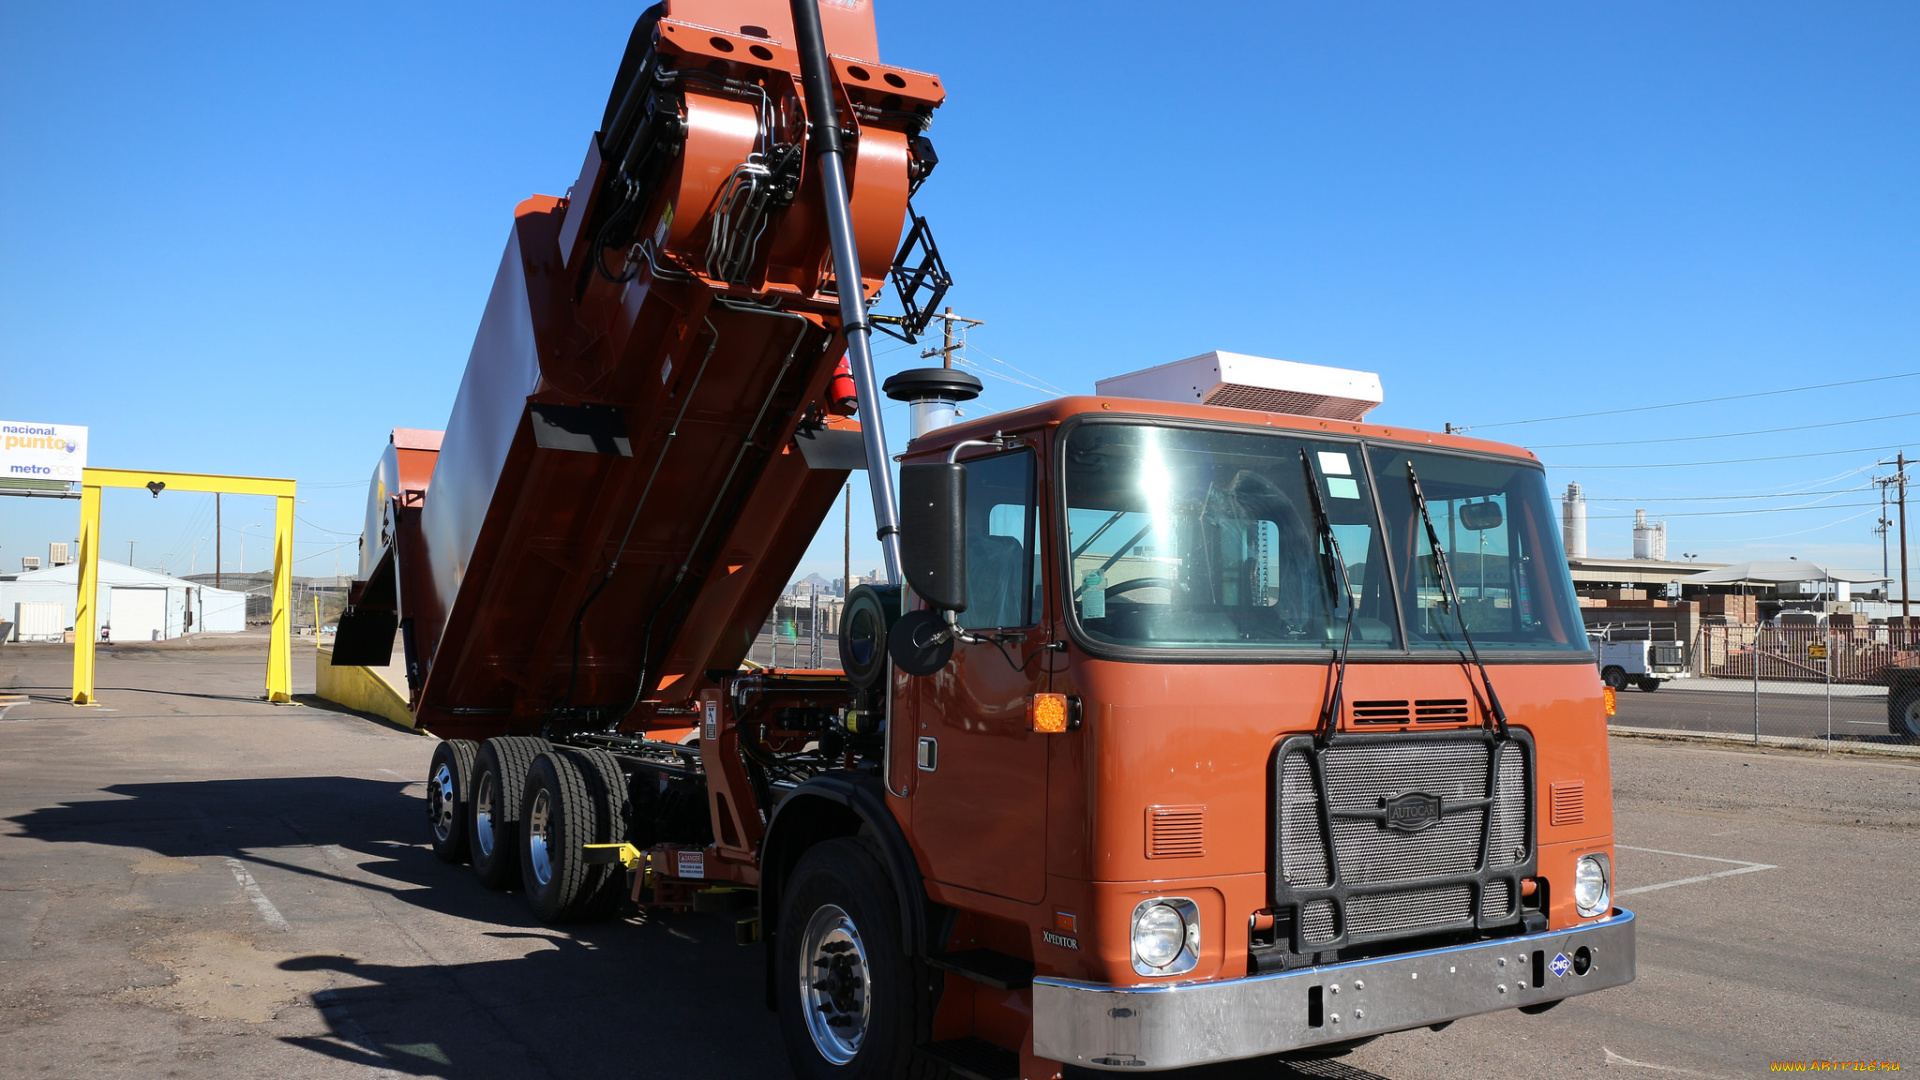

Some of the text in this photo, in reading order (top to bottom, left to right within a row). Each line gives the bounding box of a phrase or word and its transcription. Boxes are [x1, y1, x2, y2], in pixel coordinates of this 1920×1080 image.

[2, 425, 57, 436] nacional.
[5, 435, 67, 450] punto
[1391, 804, 1435, 819] AUTOCAR
[1043, 930, 1078, 949] XPEDITOR
[1551, 959, 1568, 971] CNG
